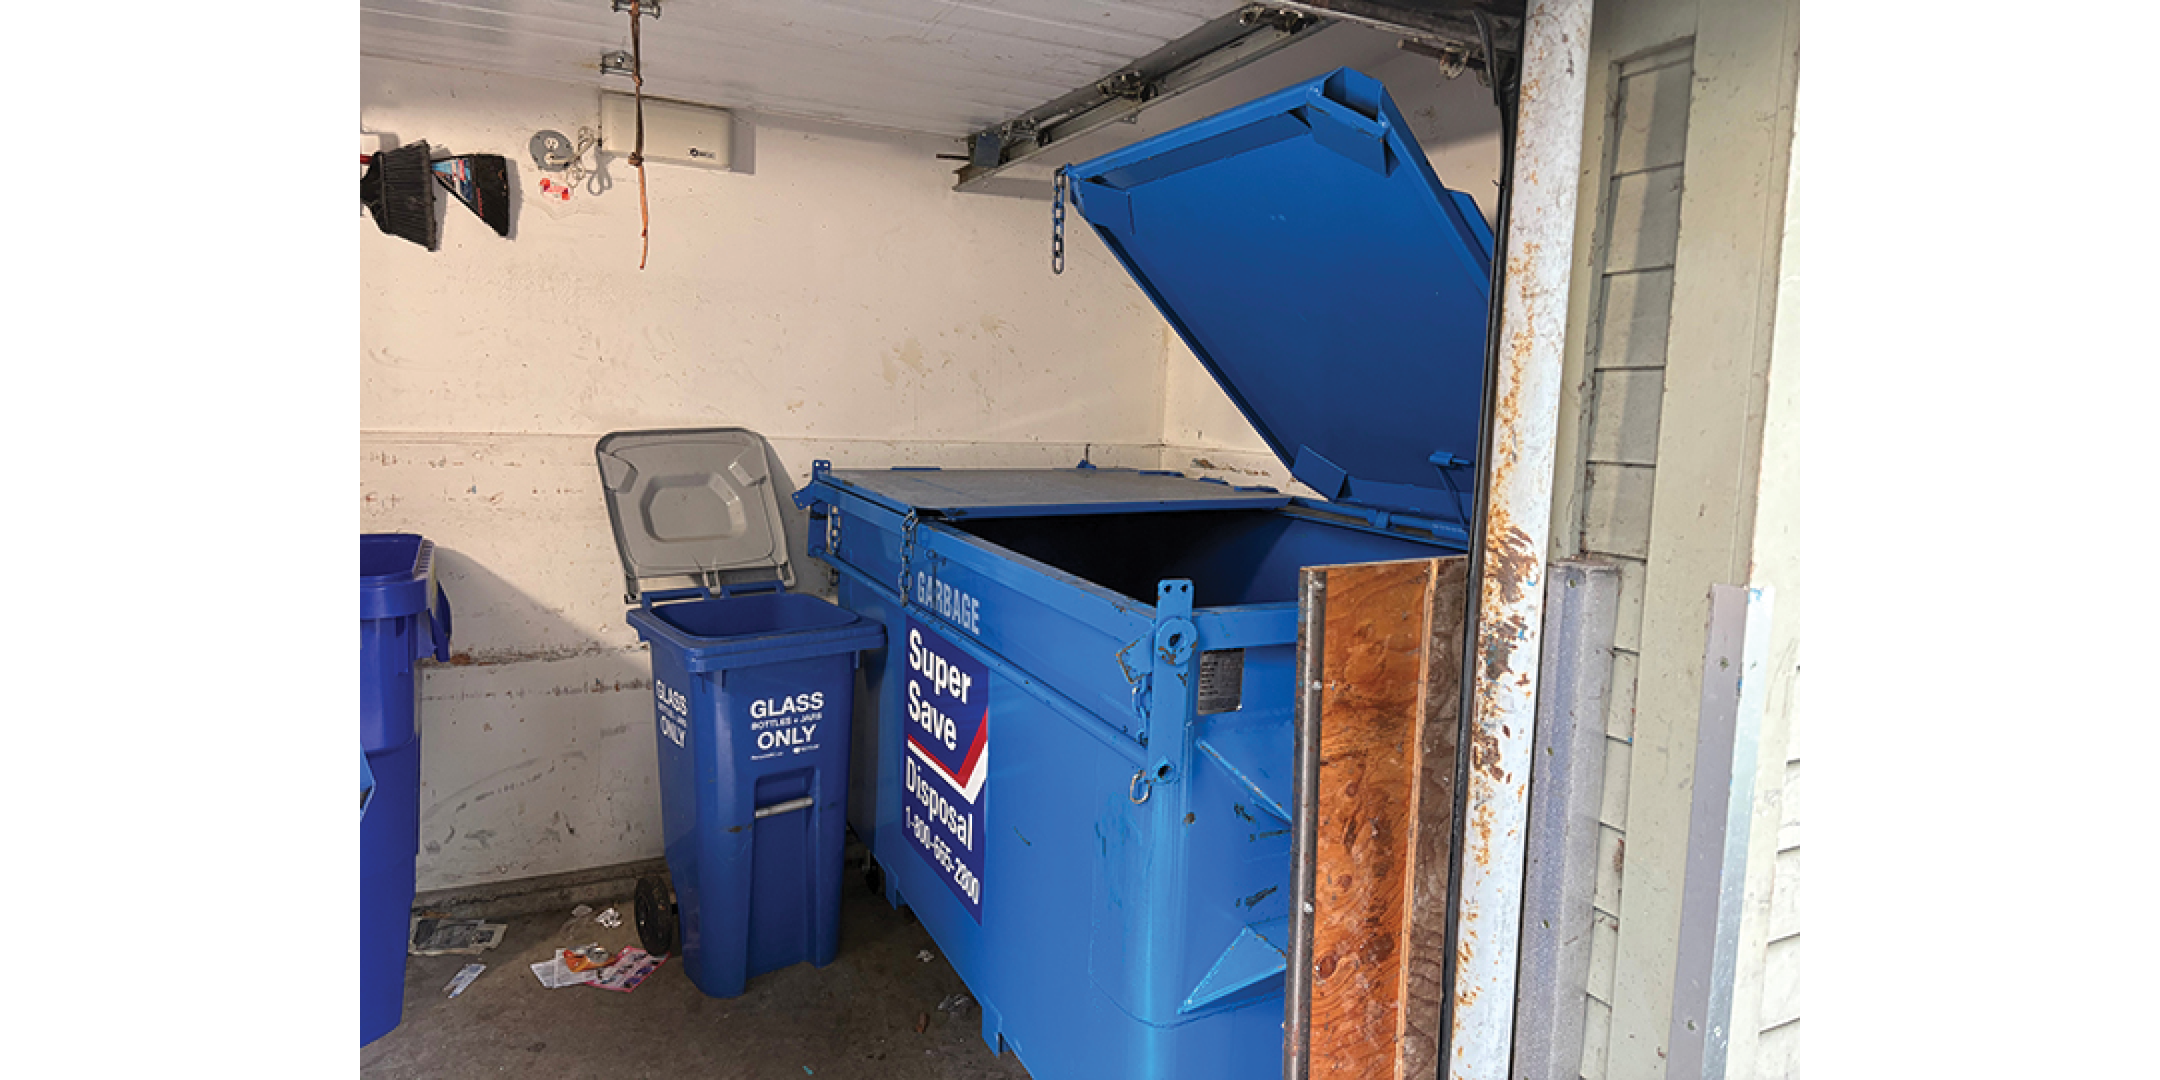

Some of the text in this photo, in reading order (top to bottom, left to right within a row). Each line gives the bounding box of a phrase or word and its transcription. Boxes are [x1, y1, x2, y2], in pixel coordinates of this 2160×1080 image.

[917, 571, 981, 635] GARBAGE
[908, 628, 972, 704] Super
[656, 679, 688, 717] GLASS
[750, 691, 825, 718] GLASS
[907, 679, 957, 751] Save
[660, 715, 686, 749] ONLY
[757, 723, 817, 750] ONLY
[905, 755, 974, 851] Disposal
